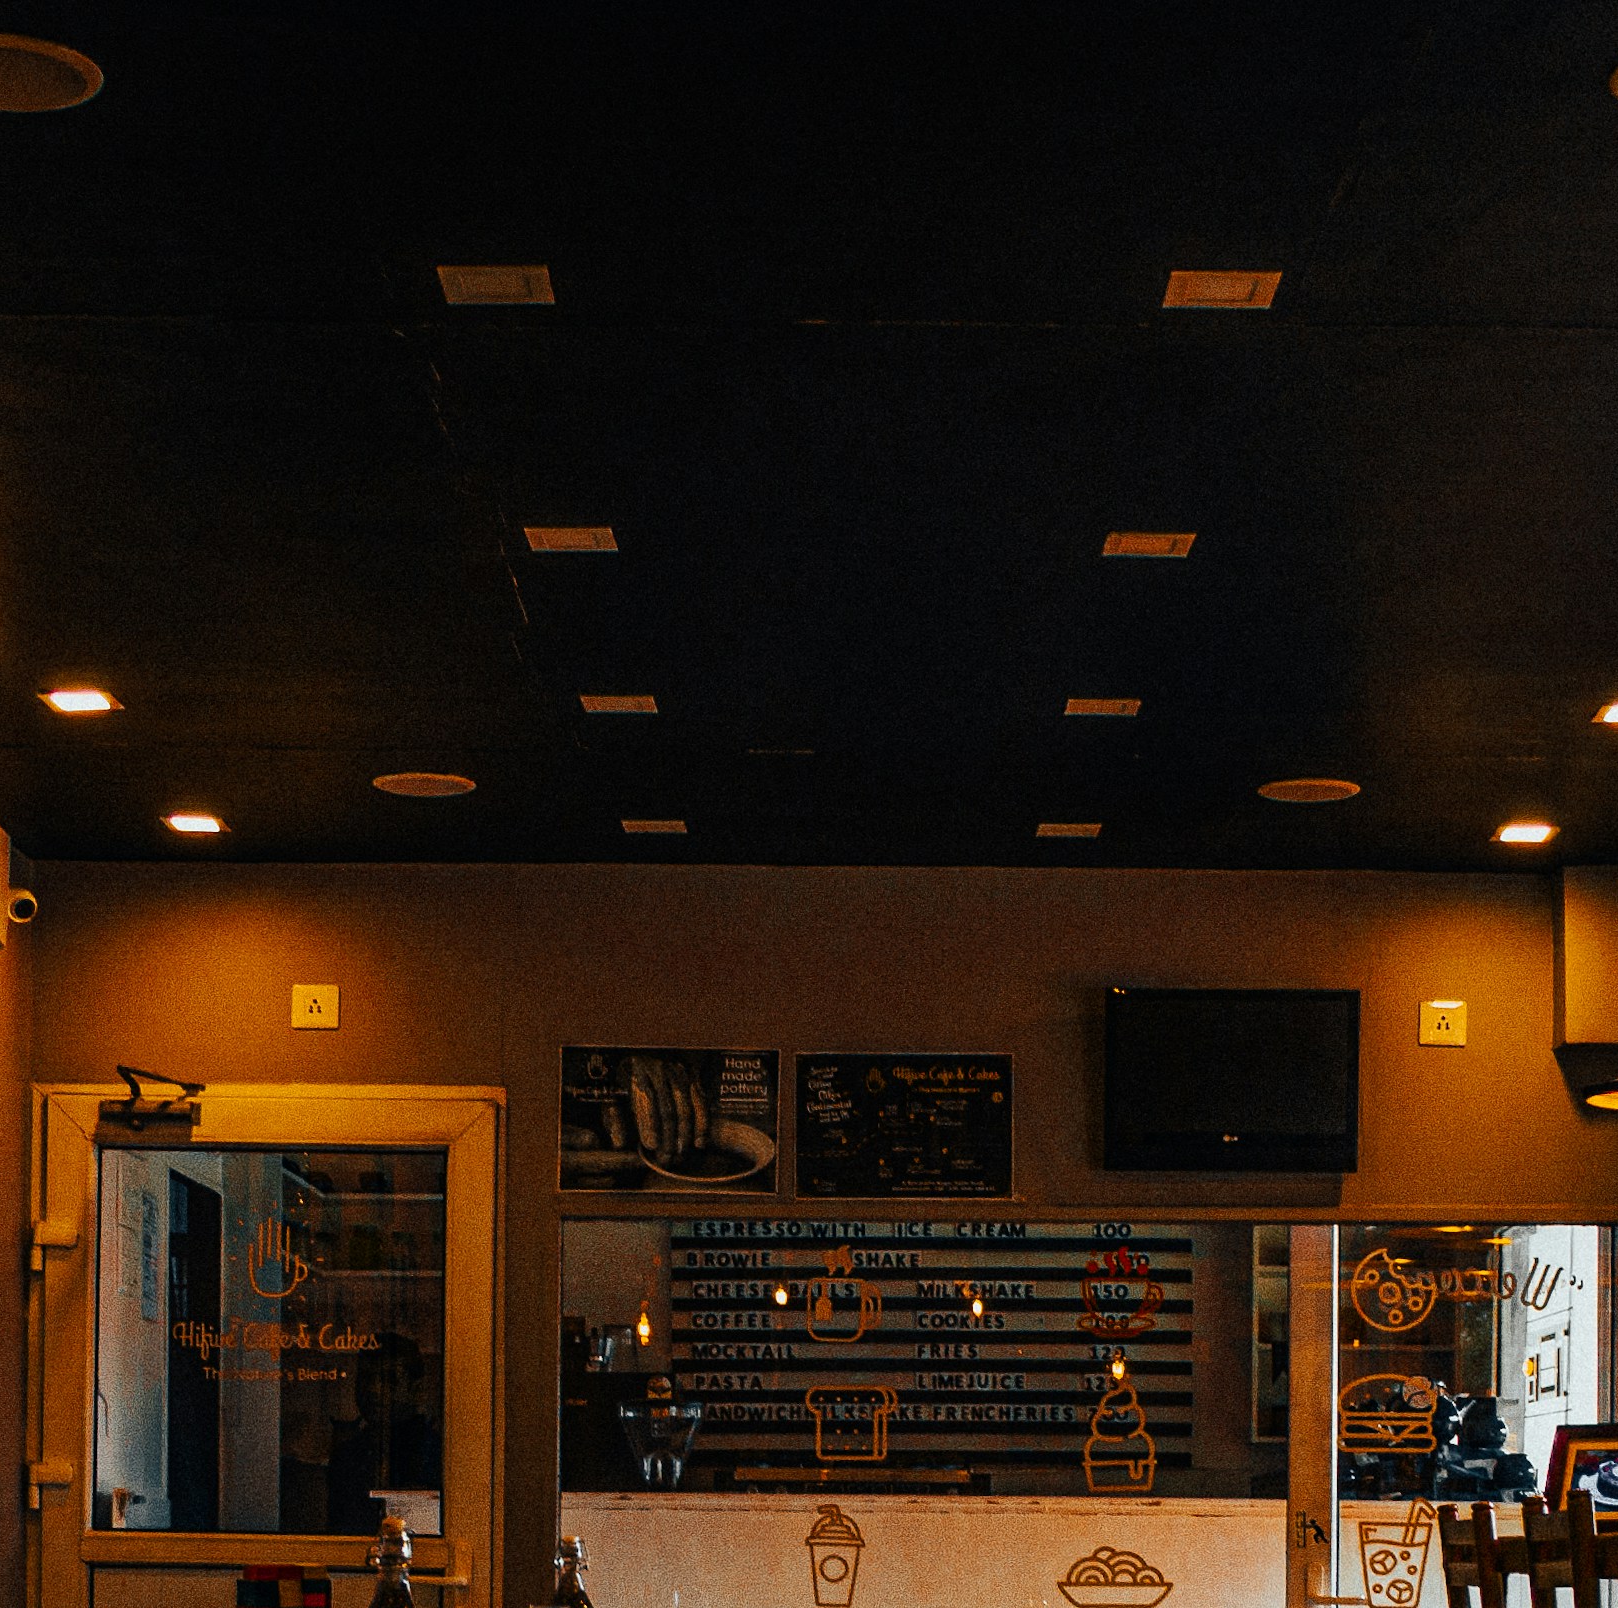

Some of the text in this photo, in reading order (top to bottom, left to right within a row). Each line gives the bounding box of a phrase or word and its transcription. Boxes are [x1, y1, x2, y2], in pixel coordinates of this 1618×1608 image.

[725, 1057, 762, 1070] Hand
[721, 1070, 762, 1082] made
[720, 1082, 768, 1096] pottery
[693, 1221, 1131, 1237] ESPRESSO WITH ICE CREAM 100
[687, 1252, 771, 1267] BROWIE
[854, 1252, 920, 1267] SHAKE
[693, 1282, 775, 1298] CHEESE
[917, 1282, 1035, 1298] MILKSHAKE
[1092, 1283, 1129, 1299] 150
[692, 1312, 771, 1328] COFFEE
[918, 1313, 1005, 1329] COOKIES
[242, 1321, 293, 1362] Cafe
[295, 1321, 311, 1350] &
[317, 1322, 381, 1351] Cakes
[692, 1343, 794, 1359] MOCKTAIL
[918, 1343, 979, 1359] FRIES
[297, 1367, 338, 1382] Blend
[695, 1374, 763, 1389] PASTA
[918, 1374, 1024, 1389] LIMEJUICE
[707, 1404, 804, 1420] ANDWICH
